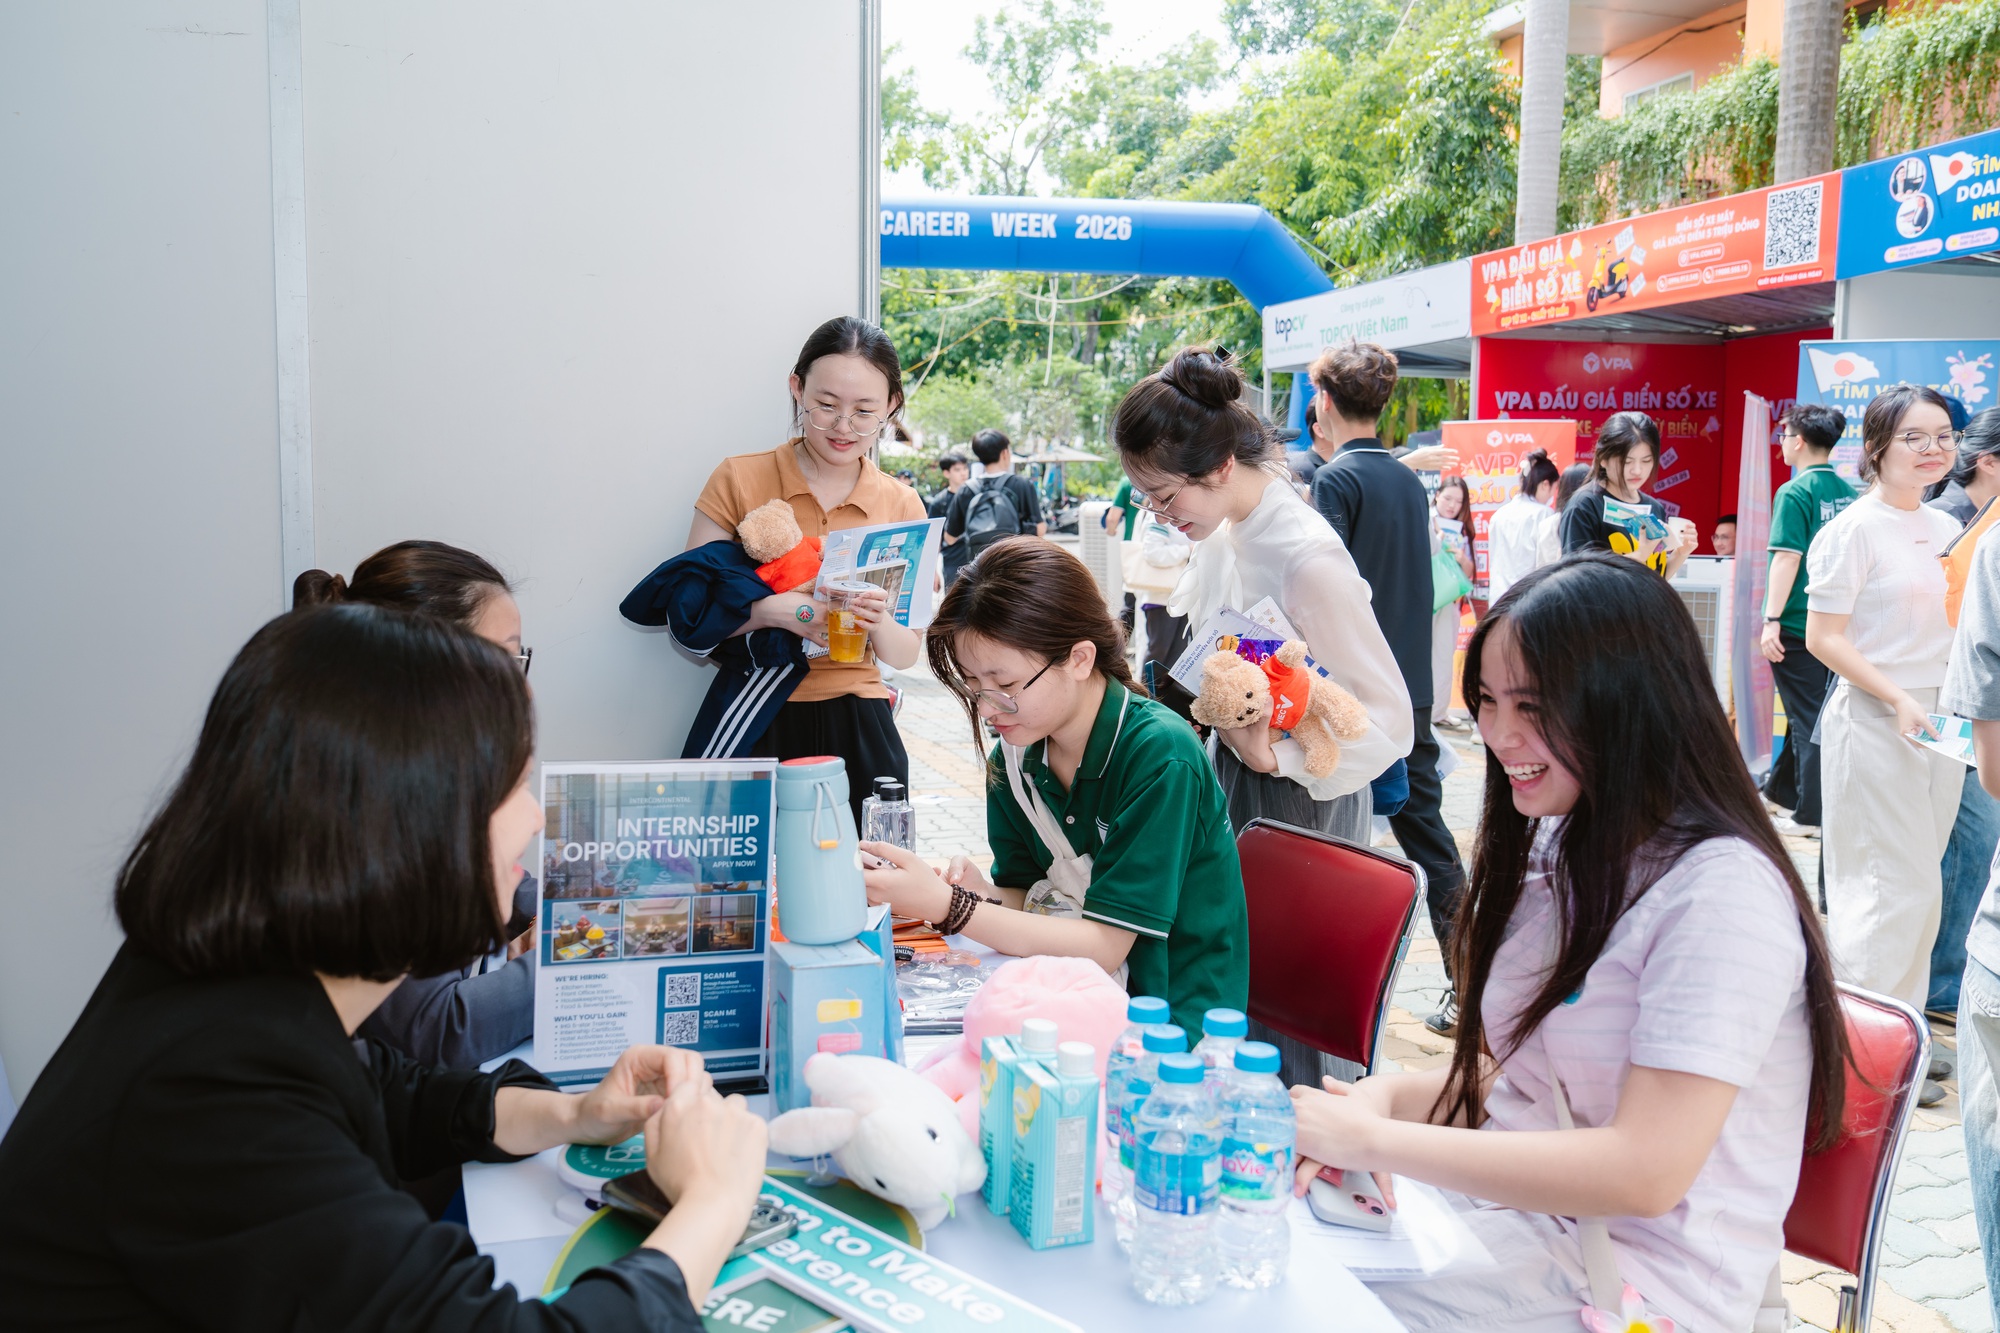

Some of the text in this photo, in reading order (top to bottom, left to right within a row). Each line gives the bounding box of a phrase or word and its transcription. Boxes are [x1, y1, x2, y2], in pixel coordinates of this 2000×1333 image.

[1706, 216, 1716, 227] XE
[1716, 209, 1735, 225] MÁY
[1972, 201, 2000, 221] NH
[880, 210, 1132, 240] CAREER WEEK 2026
[1482, 238, 1564, 284] VPA ĐẤU GIÁ
[1501, 267, 1584, 313] BIỂN SỐ XE
[1320, 315, 1409, 345] TOPCV Việt Nam
[1602, 357, 1633, 371] VPA
[1495, 382, 1717, 410] VPA ĐẤU GIÁ BIỂN SỐ XE
[1832, 381, 1869, 399] TÌM
[1769, 398, 1797, 421] VP
[1667, 414, 1698, 436] BIỂN
[1504, 433, 1534, 444] VPA
[617, 815, 759, 838] INTERNSHIP
[563, 837, 758, 862] OPPORTUNITIES
[712, 860, 756, 868] APPLY NOW!
[555, 973, 609, 983] WE'RE HIRING:
[704, 972, 724, 980] SCAN
[579, 1013, 605, 1021] YOU'LL
[704, 1010, 724, 1018] SCAN
[765, 1239, 926, 1324] erence
[819, 1224, 873, 1258] to
[868, 1249, 1005, 1324] Make
